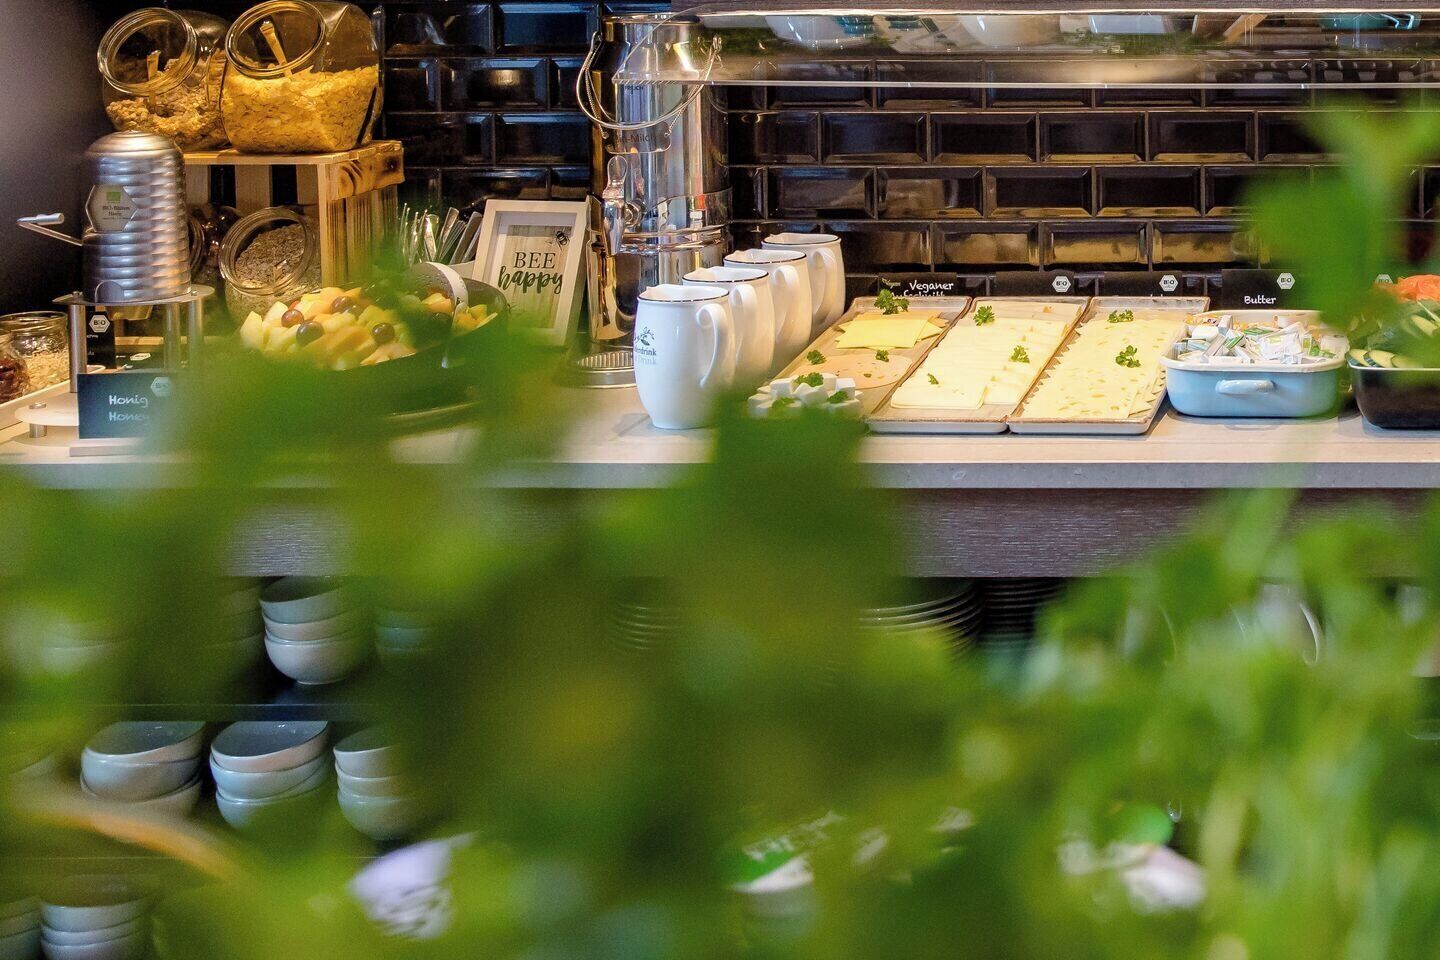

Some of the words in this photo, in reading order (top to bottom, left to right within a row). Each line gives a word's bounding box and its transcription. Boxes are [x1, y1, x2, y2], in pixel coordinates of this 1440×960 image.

[513, 251, 556, 269] BEE
[497, 266, 563, 295] happy
[909, 282, 955, 294] Veganer
[1244, 295, 1276, 305] Butter
[108, 394, 148, 408] Honig
